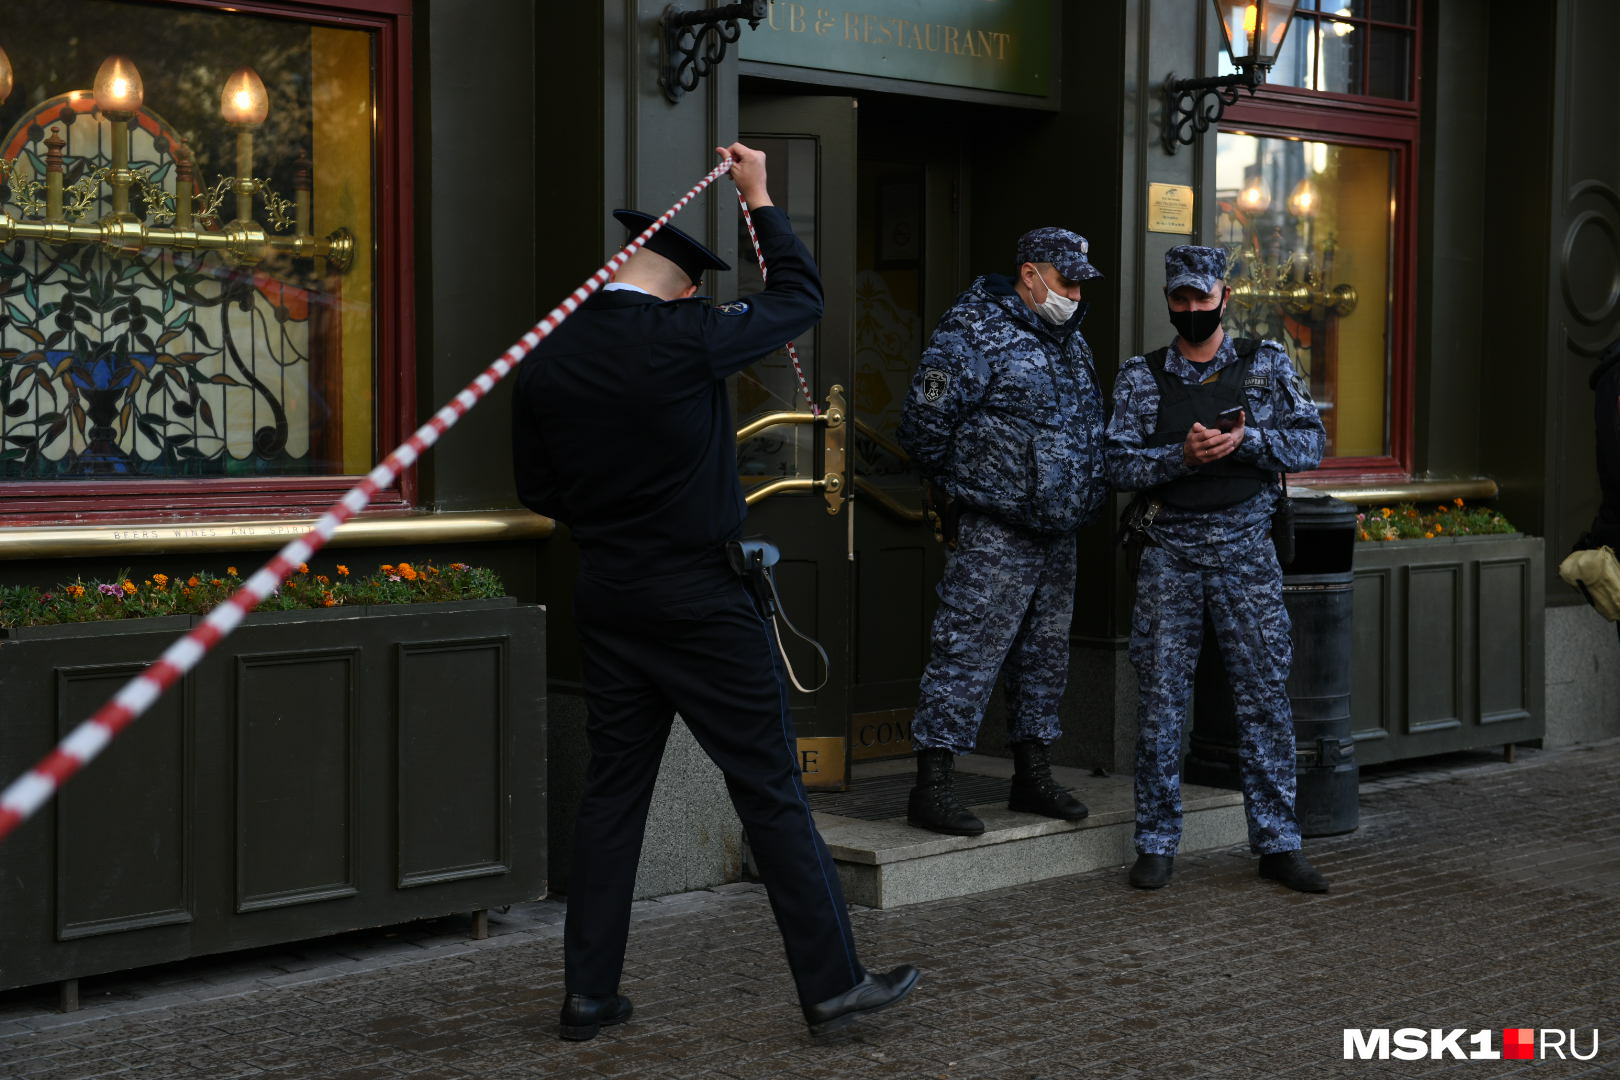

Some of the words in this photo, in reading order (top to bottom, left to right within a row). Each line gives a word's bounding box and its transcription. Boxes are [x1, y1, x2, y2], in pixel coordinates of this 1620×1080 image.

[768, 1, 807, 32] UB
[815, 7, 837, 36] &
[843, 12, 1011, 60] RESTAURANT
[114, 529, 158, 540] BEERS
[174, 528, 217, 538] WINES
[269, 525, 312, 535] SPIRIT
